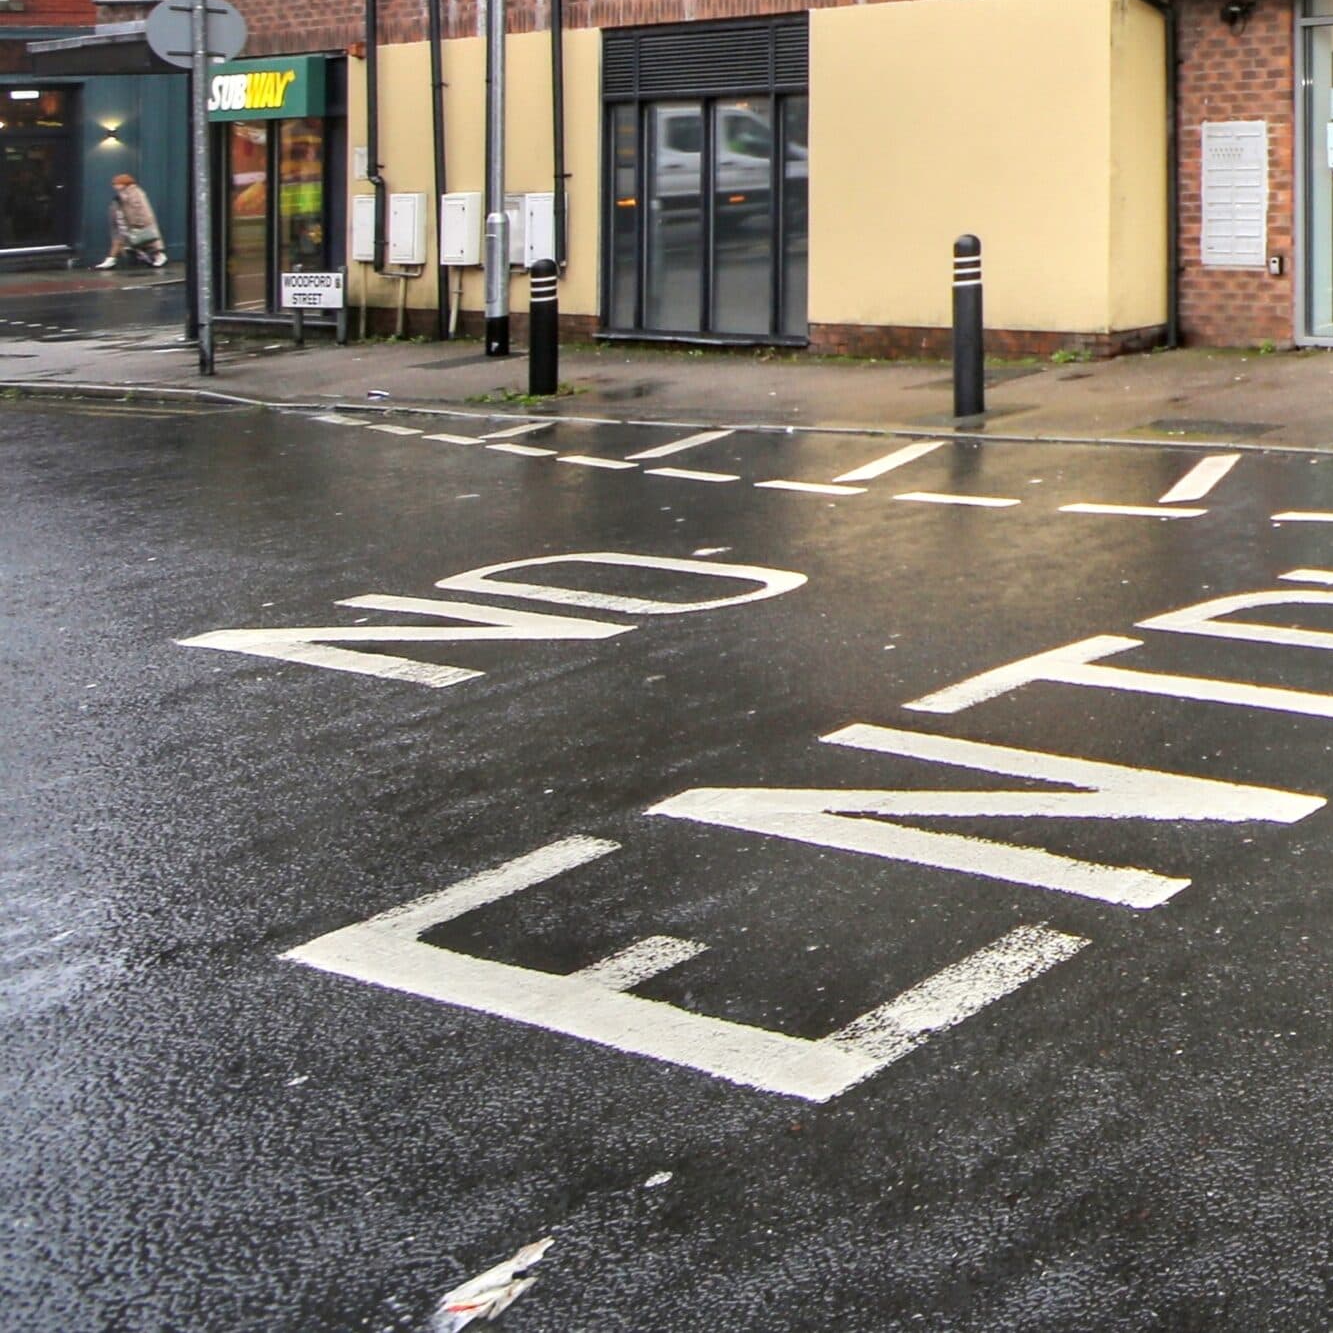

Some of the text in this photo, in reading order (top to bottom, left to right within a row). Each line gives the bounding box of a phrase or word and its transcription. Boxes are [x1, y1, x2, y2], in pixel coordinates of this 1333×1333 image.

[207, 69, 296, 111] SUBWAY
[284, 275, 331, 288] WOODFORD
[292, 292, 322, 305] STREET
[177, 551, 809, 688] NO
